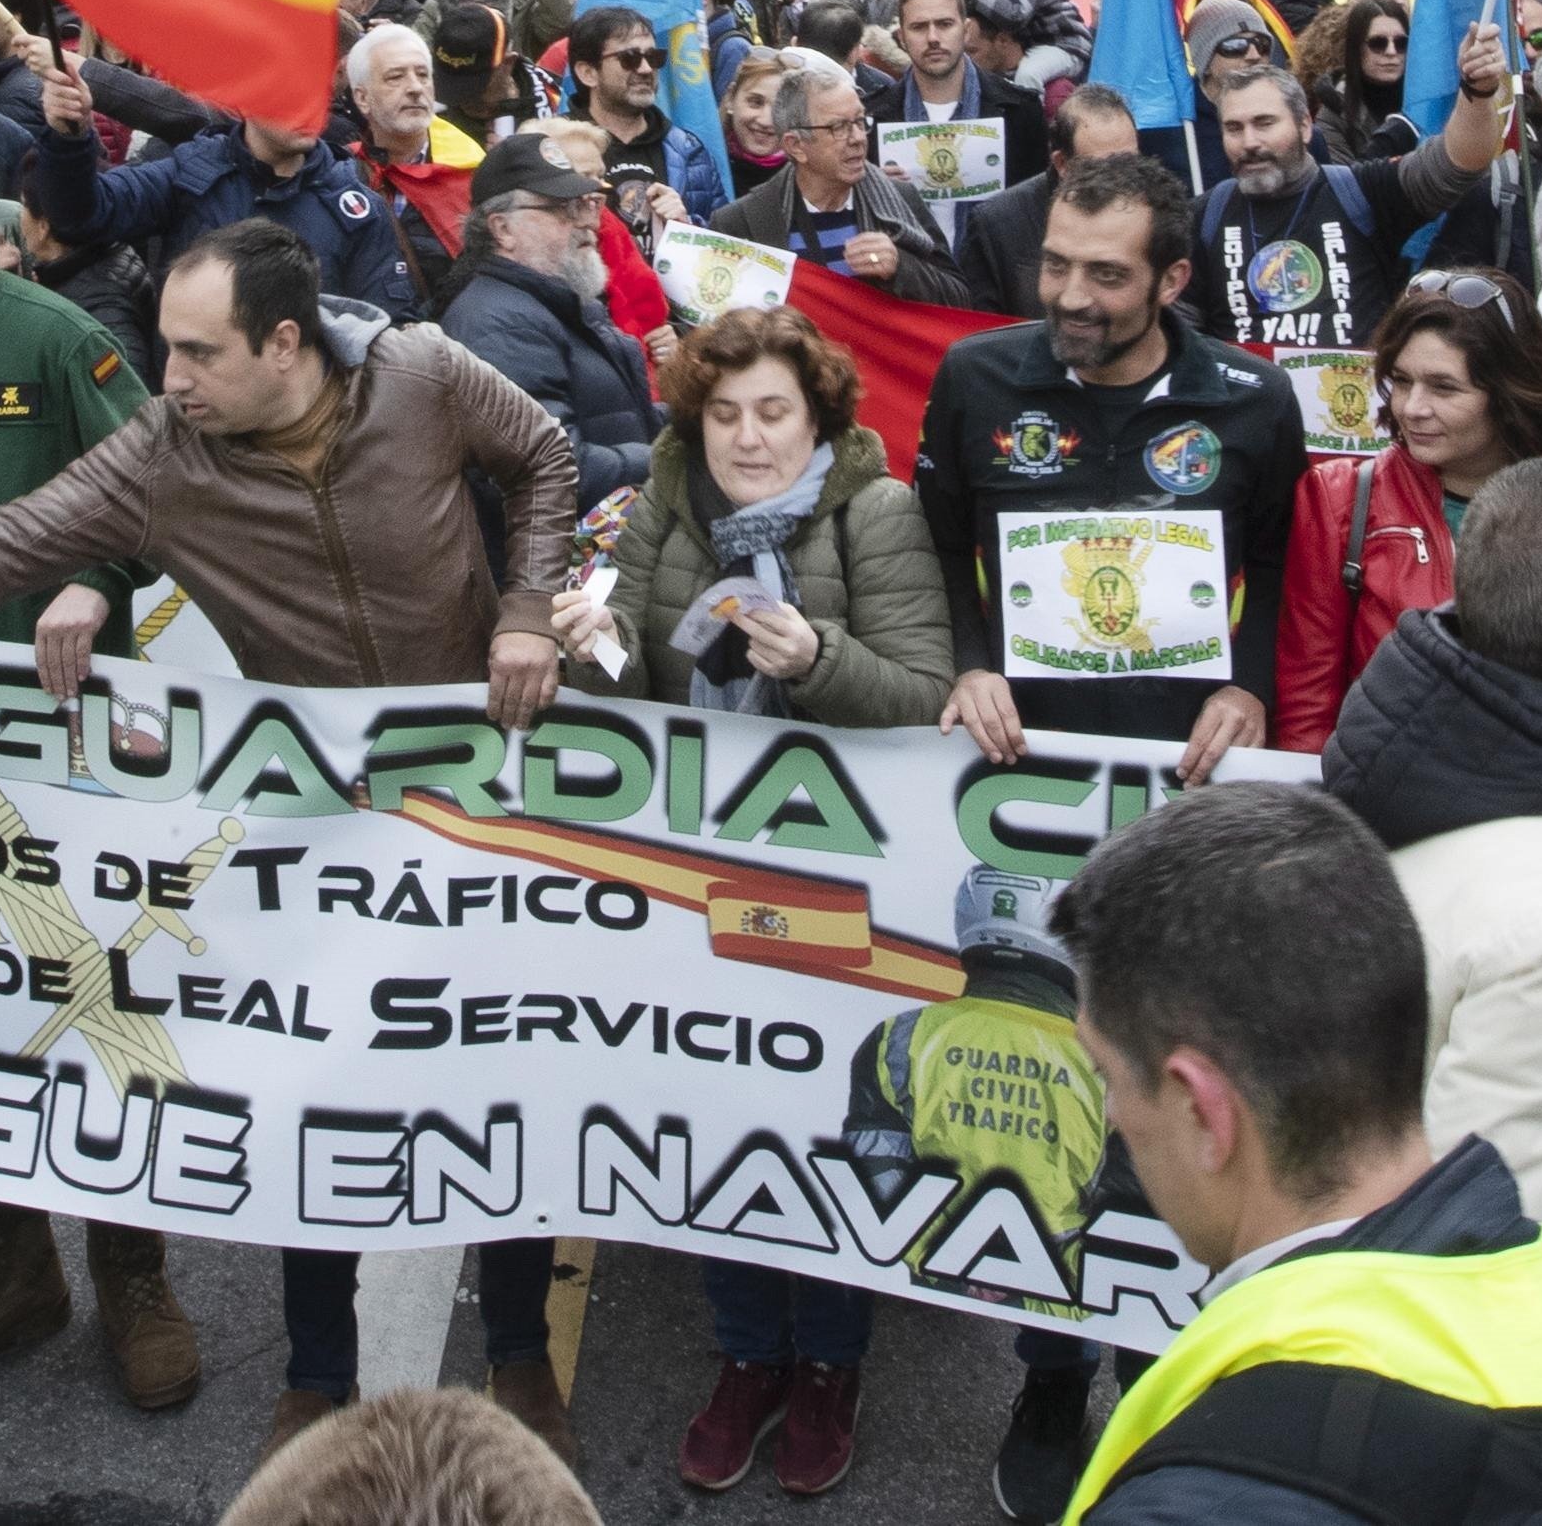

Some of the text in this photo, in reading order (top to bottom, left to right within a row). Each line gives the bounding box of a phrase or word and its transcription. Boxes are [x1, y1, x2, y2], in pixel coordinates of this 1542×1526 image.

[1262, 313, 1321, 346] YA!!
[1007, 517, 1215, 553] POR IMPERATIVO LEGAL
[1010, 634, 1223, 673] OBLIGADOS A MARCHAR
[945, 1046, 1071, 1088] GUARDIA
[970, 1076, 1042, 1111] CIVIL
[947, 1101, 1060, 1145] TRAFICO
[298, 1106, 523, 1229] EN
